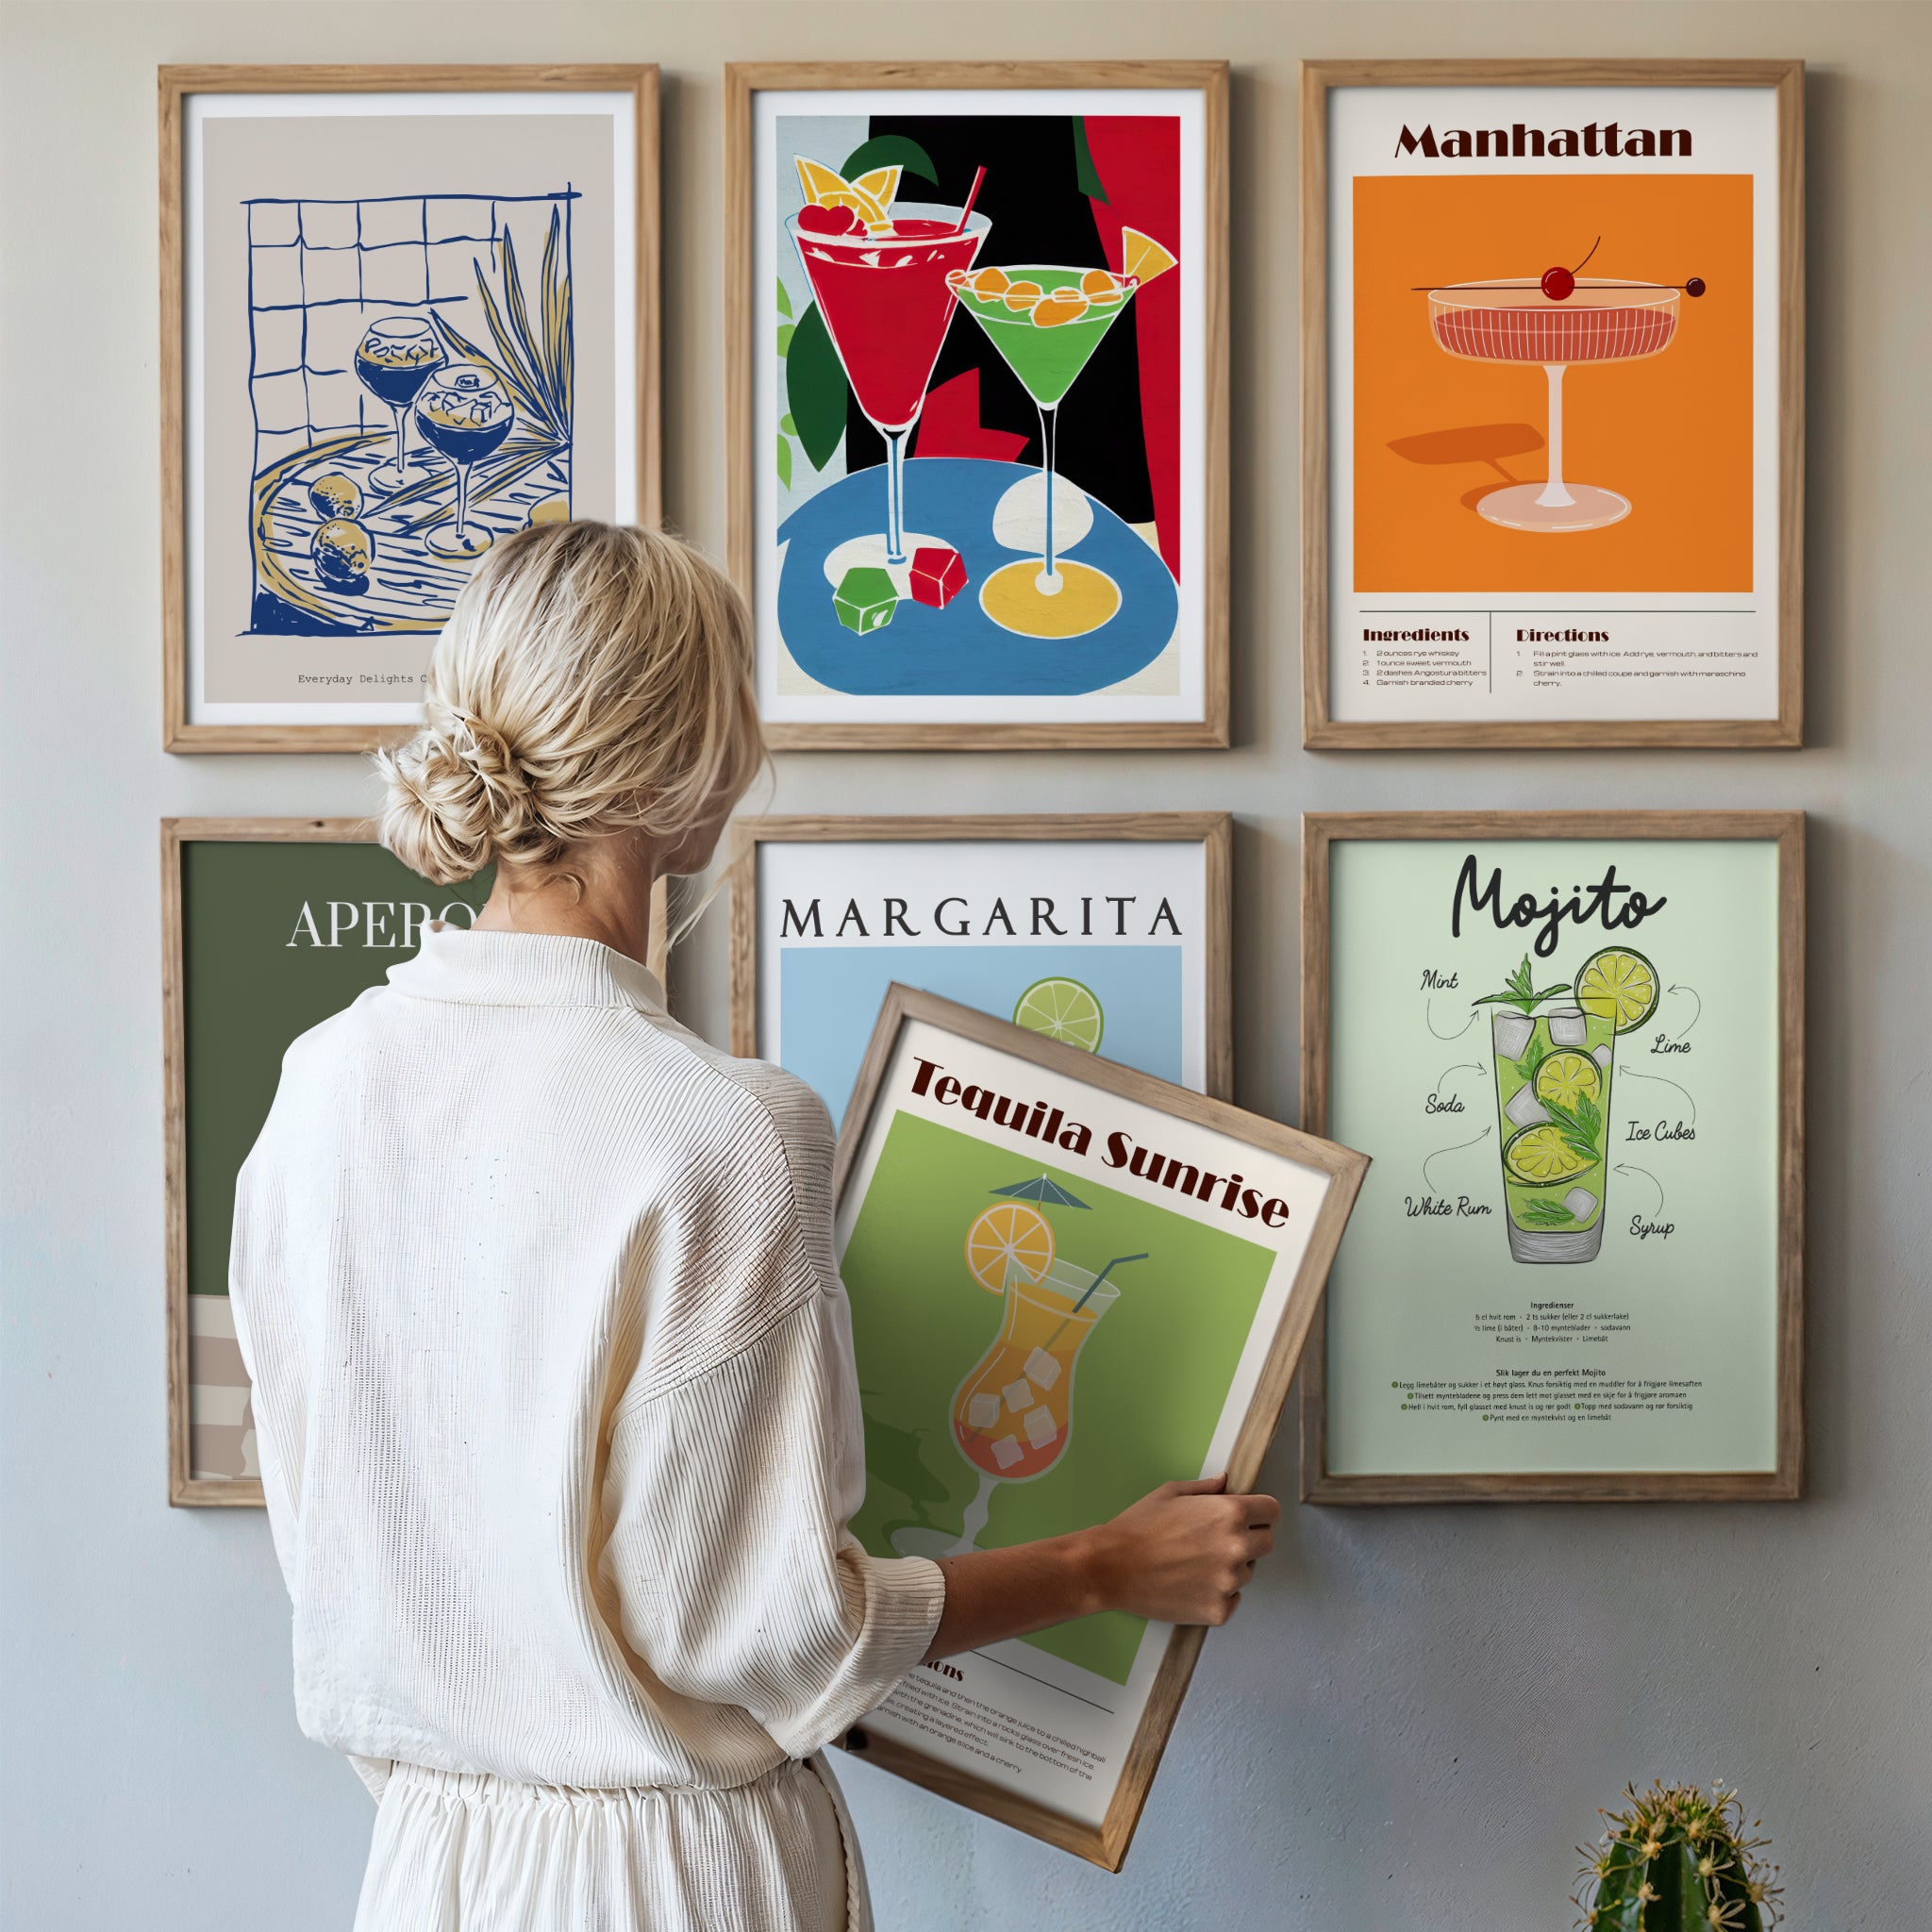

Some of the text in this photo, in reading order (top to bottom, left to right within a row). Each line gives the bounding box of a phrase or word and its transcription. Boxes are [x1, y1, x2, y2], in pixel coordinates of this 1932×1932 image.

[1394, 122, 1691, 158] Manhattan
[1363, 628, 1470, 641] Ingredients
[1517, 629, 1608, 641] Directions
[298, 674, 352, 685] Everyday
[359, 674, 413, 685] Delights
[780, 896, 1182, 937] MARGARITA
[1452, 854, 1668, 958] Mojito
[286, 900, 488, 948] APERO
[1421, 970, 1458, 990] Mint
[1651, 1034, 1691, 1054] Lime
[1425, 1093, 1465, 1114] Soda
[1625, 1120, 1695, 1141] Ice Cubes
[911, 1057, 1290, 1227] Tequila Sunrise
[1406, 1196, 1491, 1217] White Rum
[1630, 1215, 1674, 1240] Syrup
[1530, 1302, 1574, 1310] Ingredienser
[1551, 1324, 1591, 1333] mynteblader
[1531, 1336, 1573, 1344] Myntekvister
[1511, 1370, 1529, 1378] lager
[1582, 1369, 1606, 1377] Mojito
[1490, 1414, 1504, 1423] Pynt
[915, 1674, 941, 1692] tequila
[941, 1686, 957, 1698] and
[975, 1701, 990, 1712] the
[990, 1707, 1018, 1725] orange
[895, 1701, 929, 1721] creating
[935, 1718, 964, 1736] layered
[929, 1727, 957, 1745] orange
[951, 1702, 1083, 1764] Strain into rocks over fresh
[964, 1719, 987, 1734] which
[1039, 1752, 1069, 1770] bottom
[1078, 1769, 1092, 1780] the
